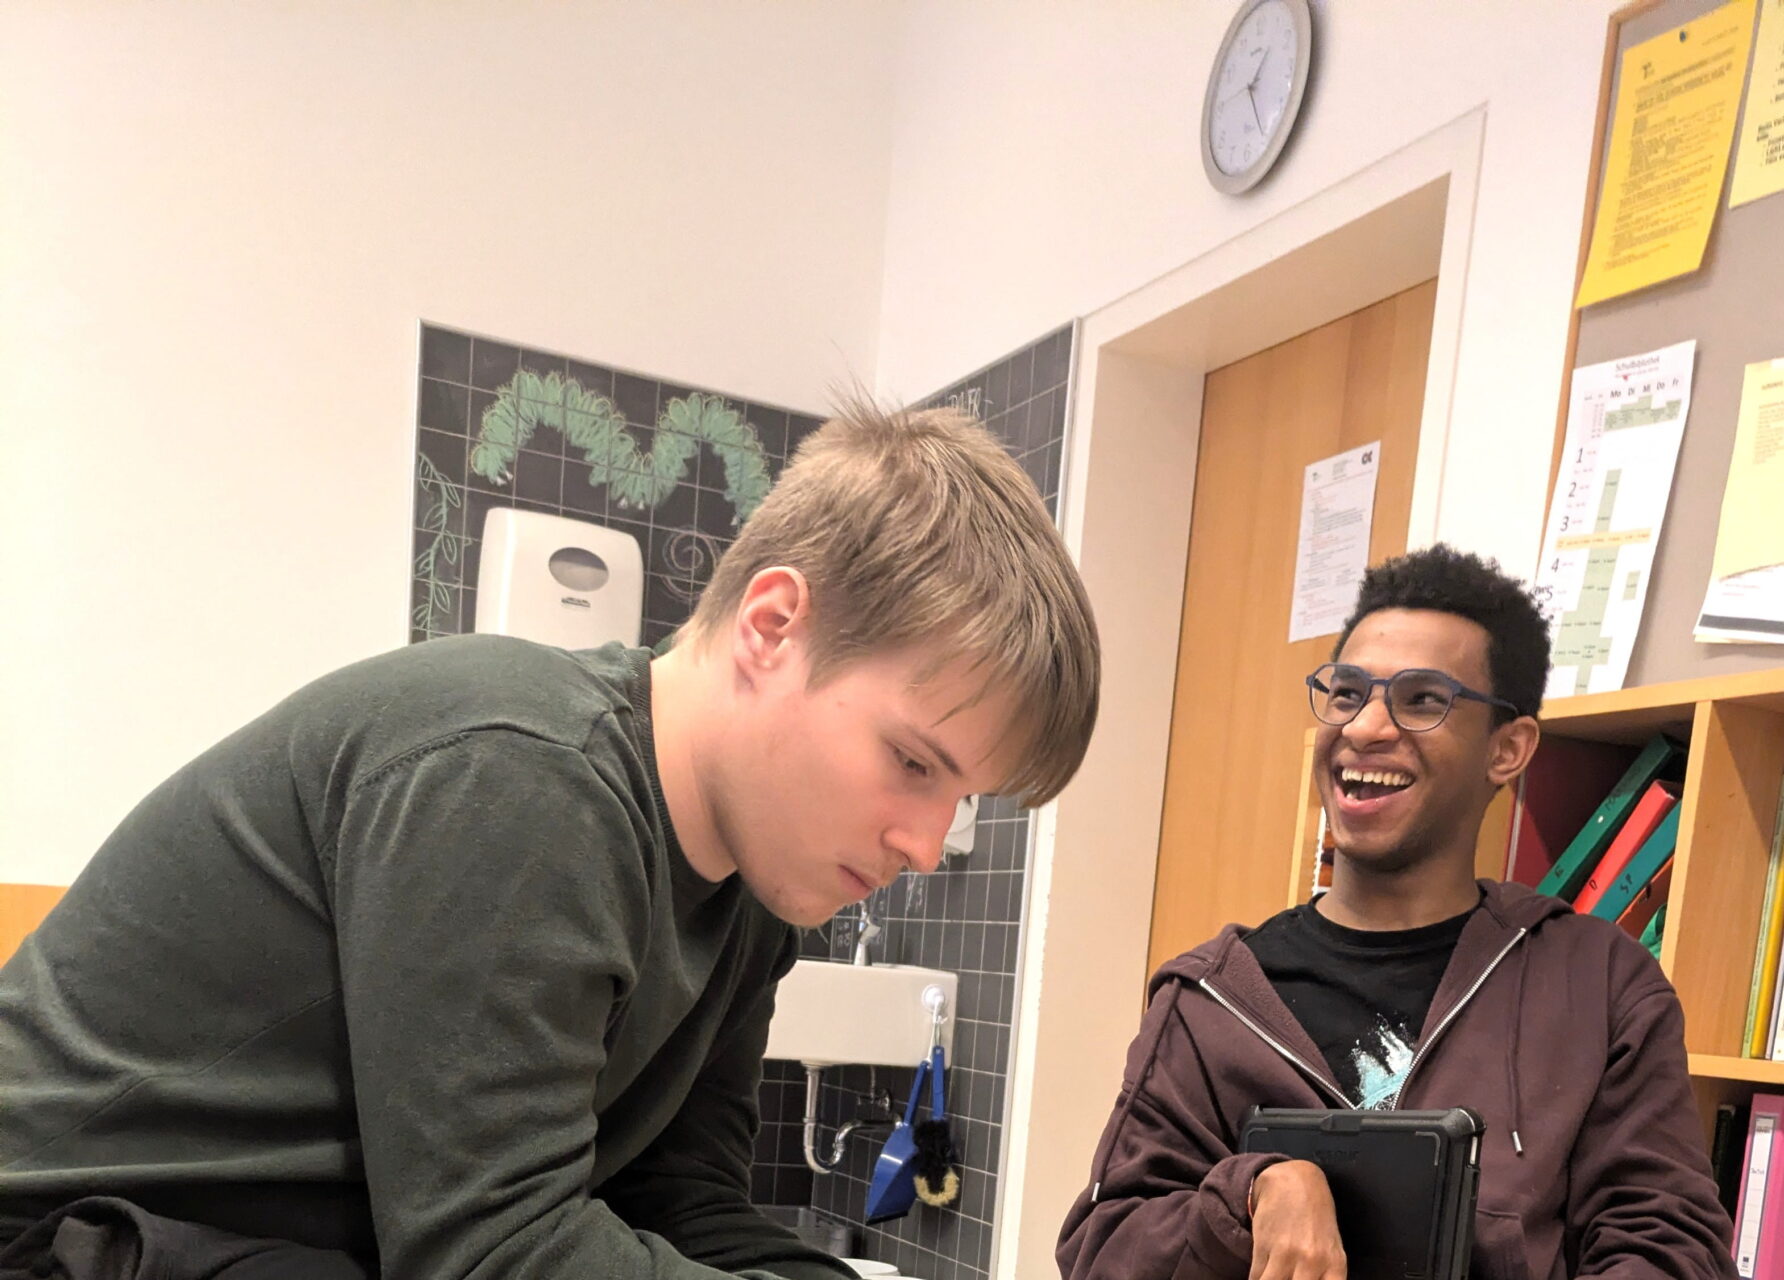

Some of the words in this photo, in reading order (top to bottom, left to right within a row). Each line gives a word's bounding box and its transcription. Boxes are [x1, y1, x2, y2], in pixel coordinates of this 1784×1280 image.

[1568, 481, 1577, 498] 2
[1560, 515, 1570, 532] 3
[1551, 558, 1560, 573] 4
